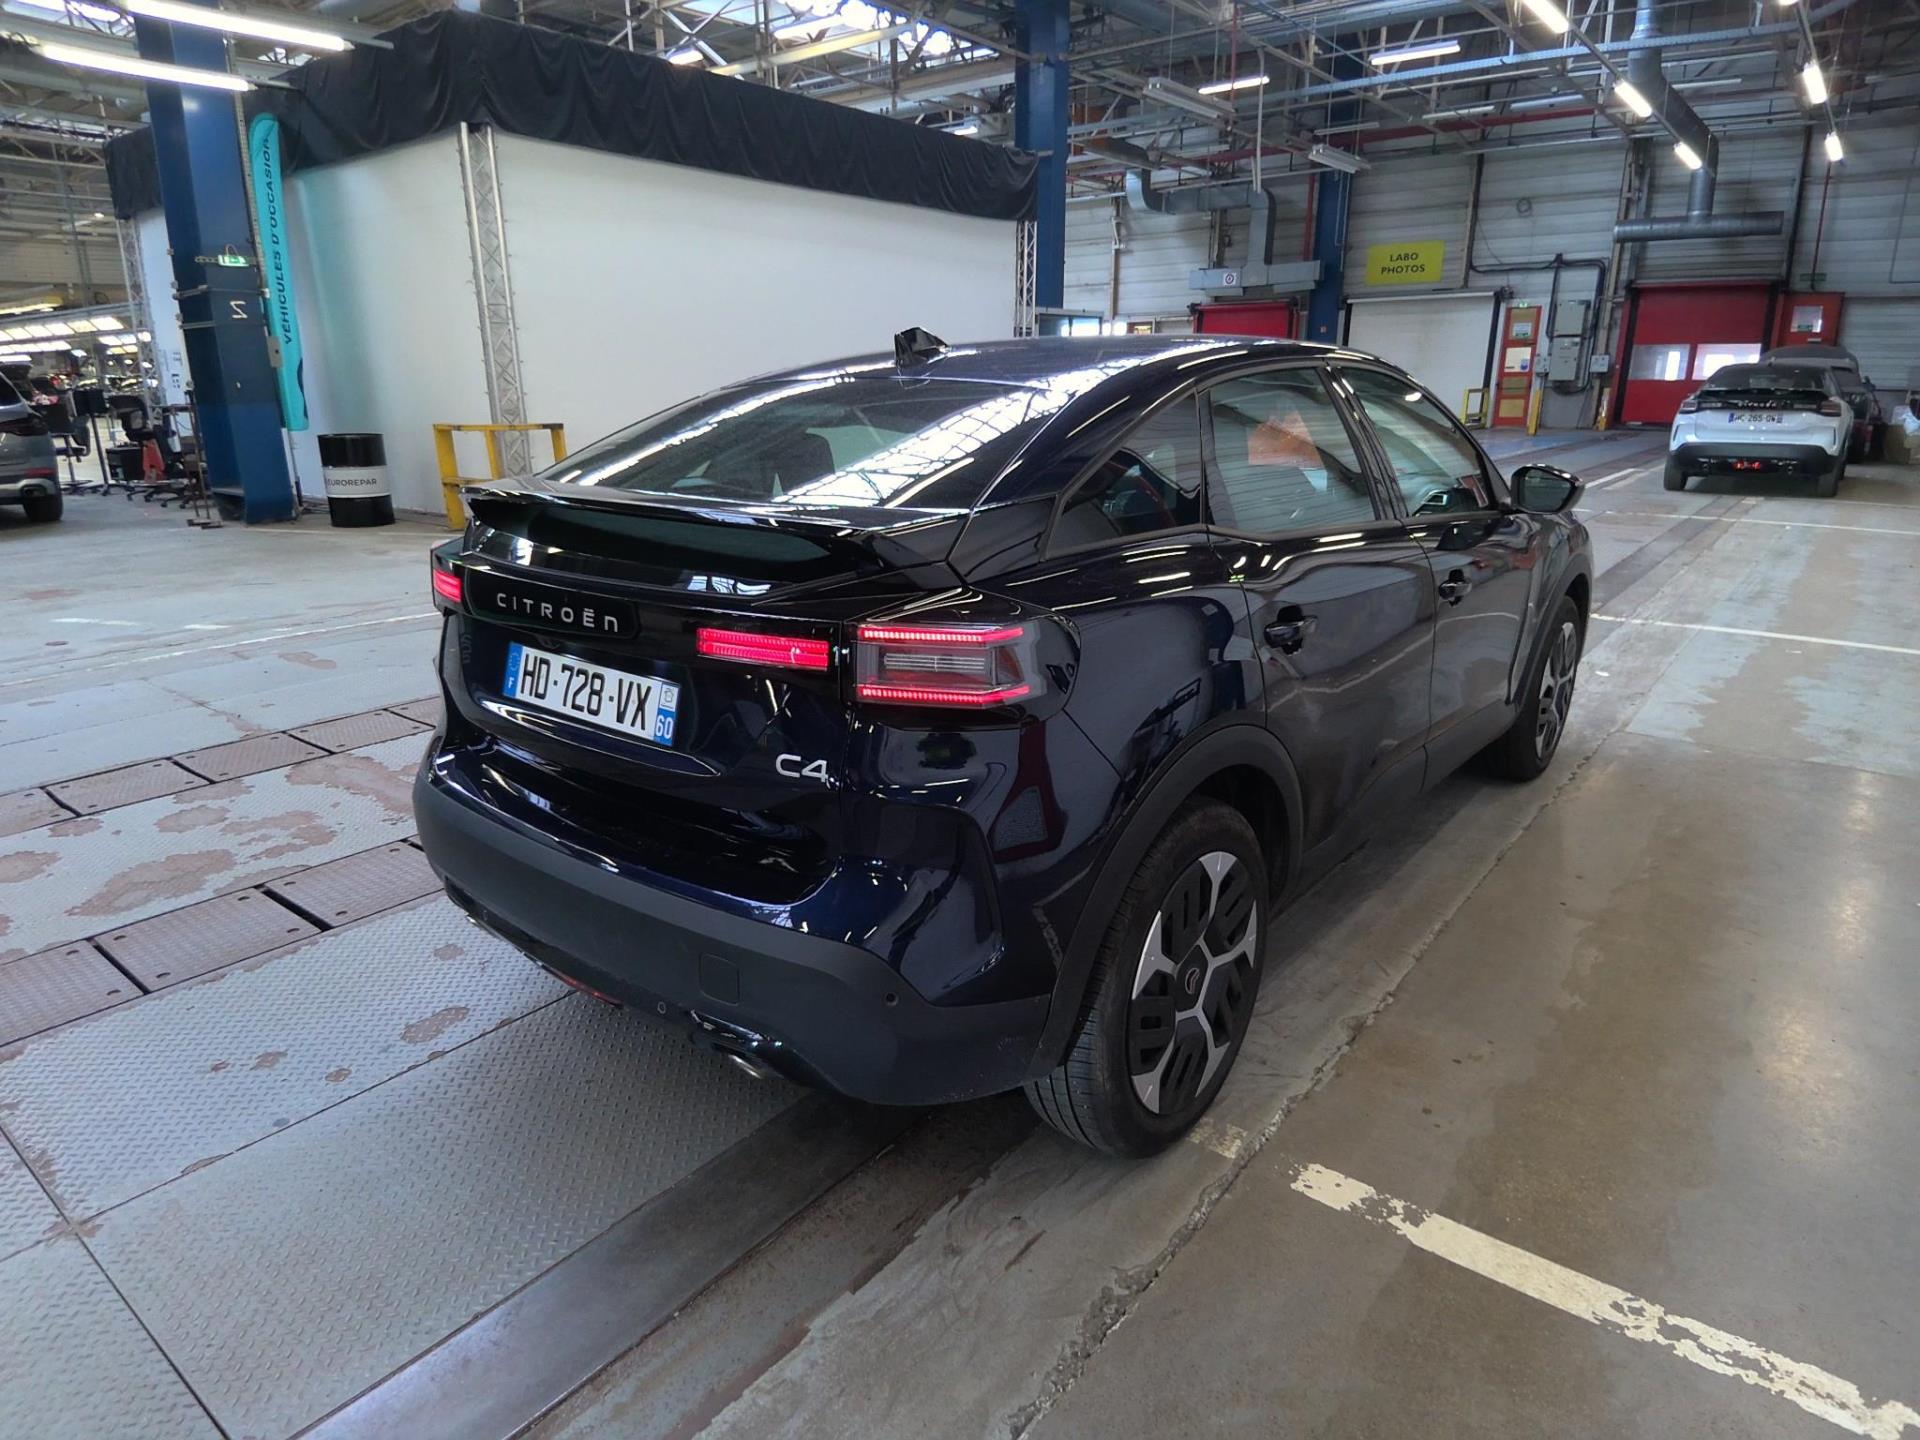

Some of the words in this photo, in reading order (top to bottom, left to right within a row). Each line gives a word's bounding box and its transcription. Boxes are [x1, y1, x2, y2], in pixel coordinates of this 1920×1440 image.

[1389, 252, 1419, 262] LABO
[1380, 263, 1426, 275] PHOTOS
[508, 677, 515, 689] F
[520, 653, 652, 731] HD-728-VX
[655, 714, 674, 739] 60
[775, 753, 829, 783] C4
